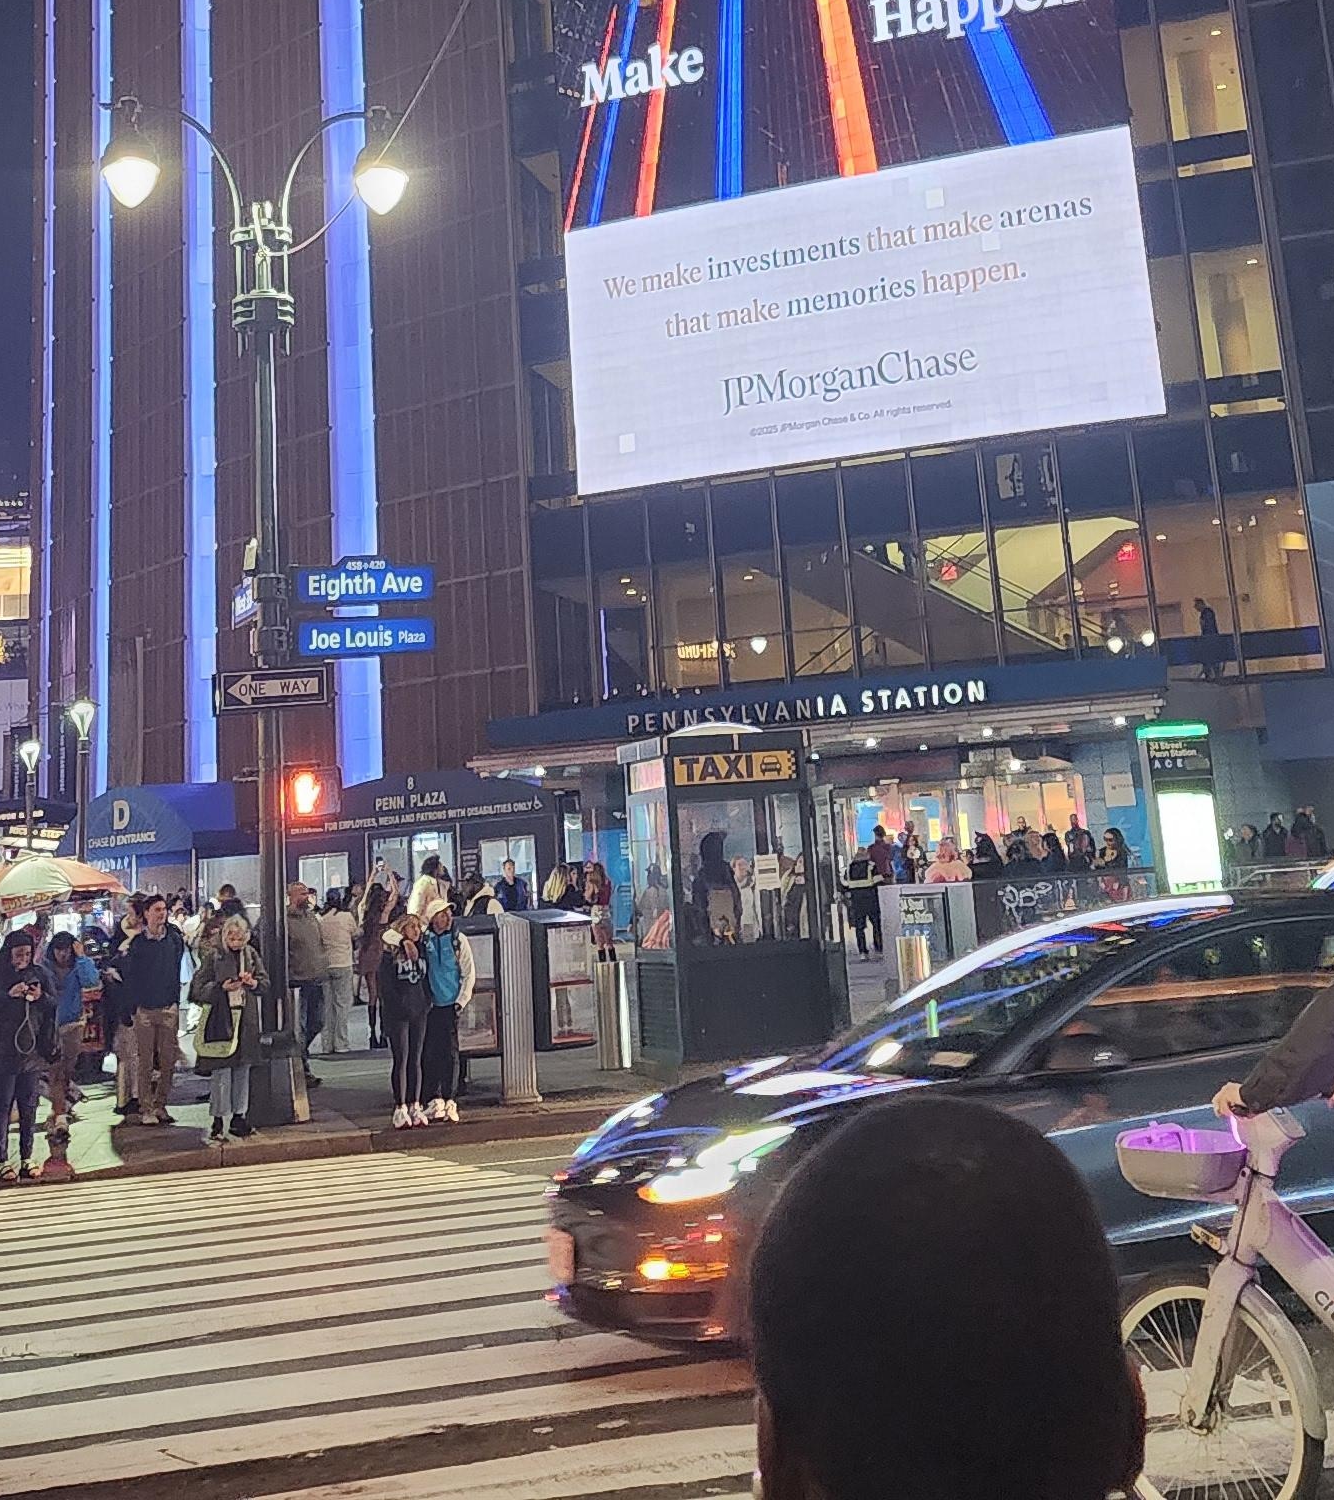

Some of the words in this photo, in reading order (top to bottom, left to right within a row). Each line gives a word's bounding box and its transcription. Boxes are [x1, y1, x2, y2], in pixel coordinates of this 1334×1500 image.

[581, 42, 705, 107] Make
[603, 276, 638, 299] We
[641, 263, 703, 293] make
[707, 232, 861, 282] investments
[865, 224, 917, 255] that
[923, 211, 993, 245] make
[999, 192, 1093, 230] arenas
[664, 312, 712, 339] that
[717, 298, 780, 329] make
[786, 277, 916, 317] memories
[921, 257, 1027, 300] happen.
[719, 345, 978, 416] JPMorganChase
[308, 572, 376, 601] Eighth
[382, 571, 423, 593] Ave
[309, 628, 340, 650] Joe
[345, 625, 393, 648] Louis
[398, 630, 426, 644] Plaza
[238, 681, 266, 697] ONE
[280, 679, 311, 694] WAY
[628, 697, 847, 734] PENNSYLVANIA
[861, 680, 987, 713] STATION
[406, 776, 415, 790] 8
[679, 754, 753, 783] TAXI
[113, 799, 130, 830] D
[324, 822, 338, 832] FOR
[339, 817, 378, 830] EMPLOYEES,
[379, 814, 400, 825] MEDIA
[401, 812, 415, 823] AND
[416, 810, 446, 822] PATRONS
[447, 807, 466, 819] WITH
[467, 803, 512, 817] DISABILITIES
[513, 800, 533, 812] ONLY
[375, 795, 405, 811] PENN
[410, 791, 447, 806] PLAZA
[116, 831, 156, 846] ENTRANCE
